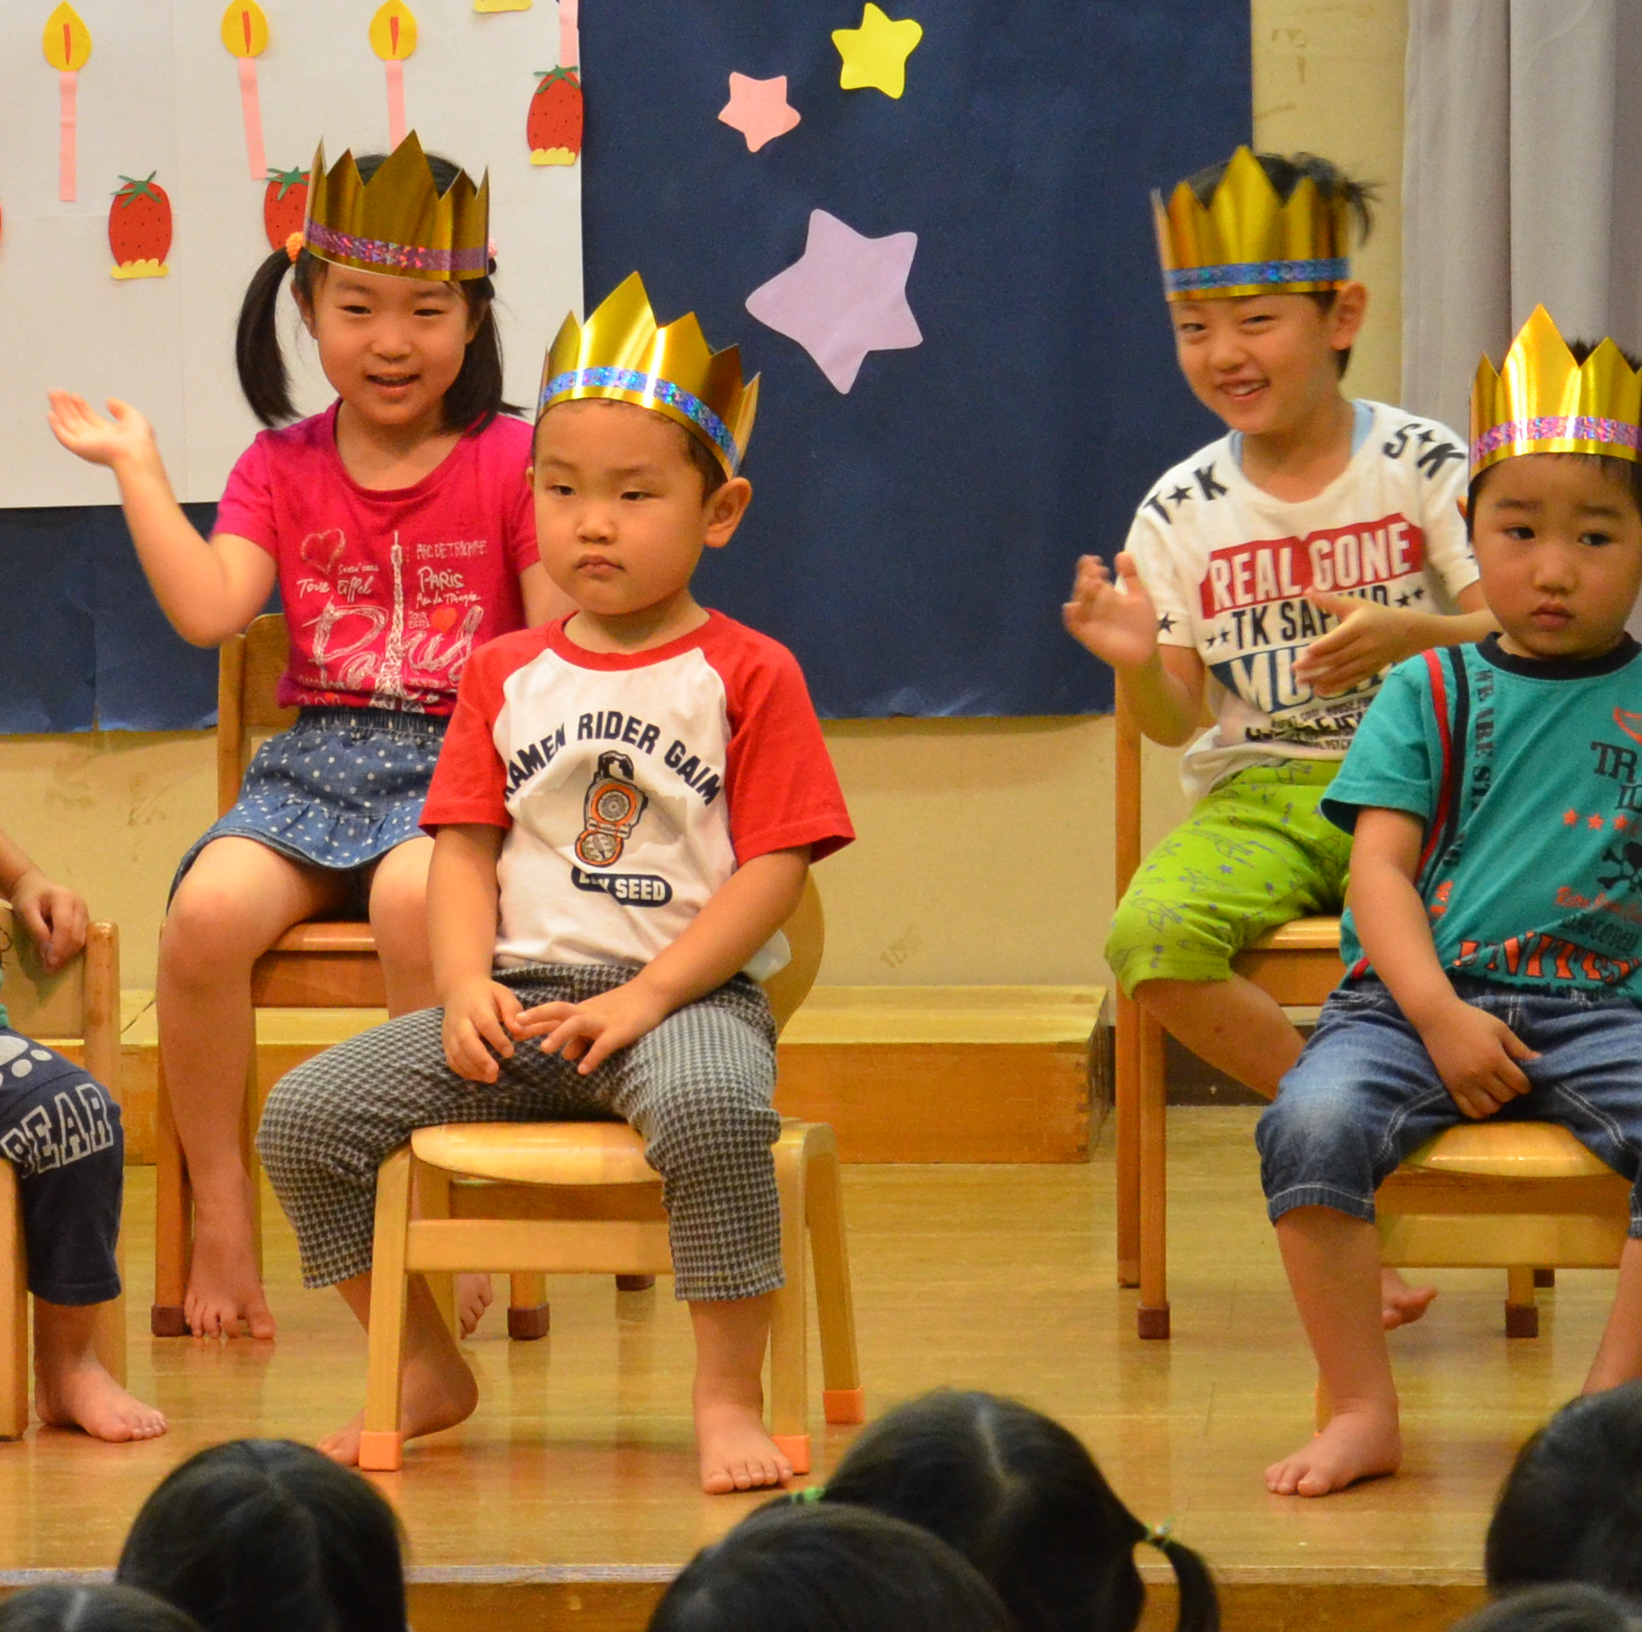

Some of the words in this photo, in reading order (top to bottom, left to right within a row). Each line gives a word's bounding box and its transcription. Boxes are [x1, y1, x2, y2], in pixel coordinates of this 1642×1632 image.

[1210, 546, 1302, 611] REAL
[1309, 521, 1412, 592] GONE
[1232, 604, 1272, 650] TK
[576, 710, 662, 757] RIDER
[663, 738, 722, 807] GAIM
[614, 878, 667, 902] SEED
